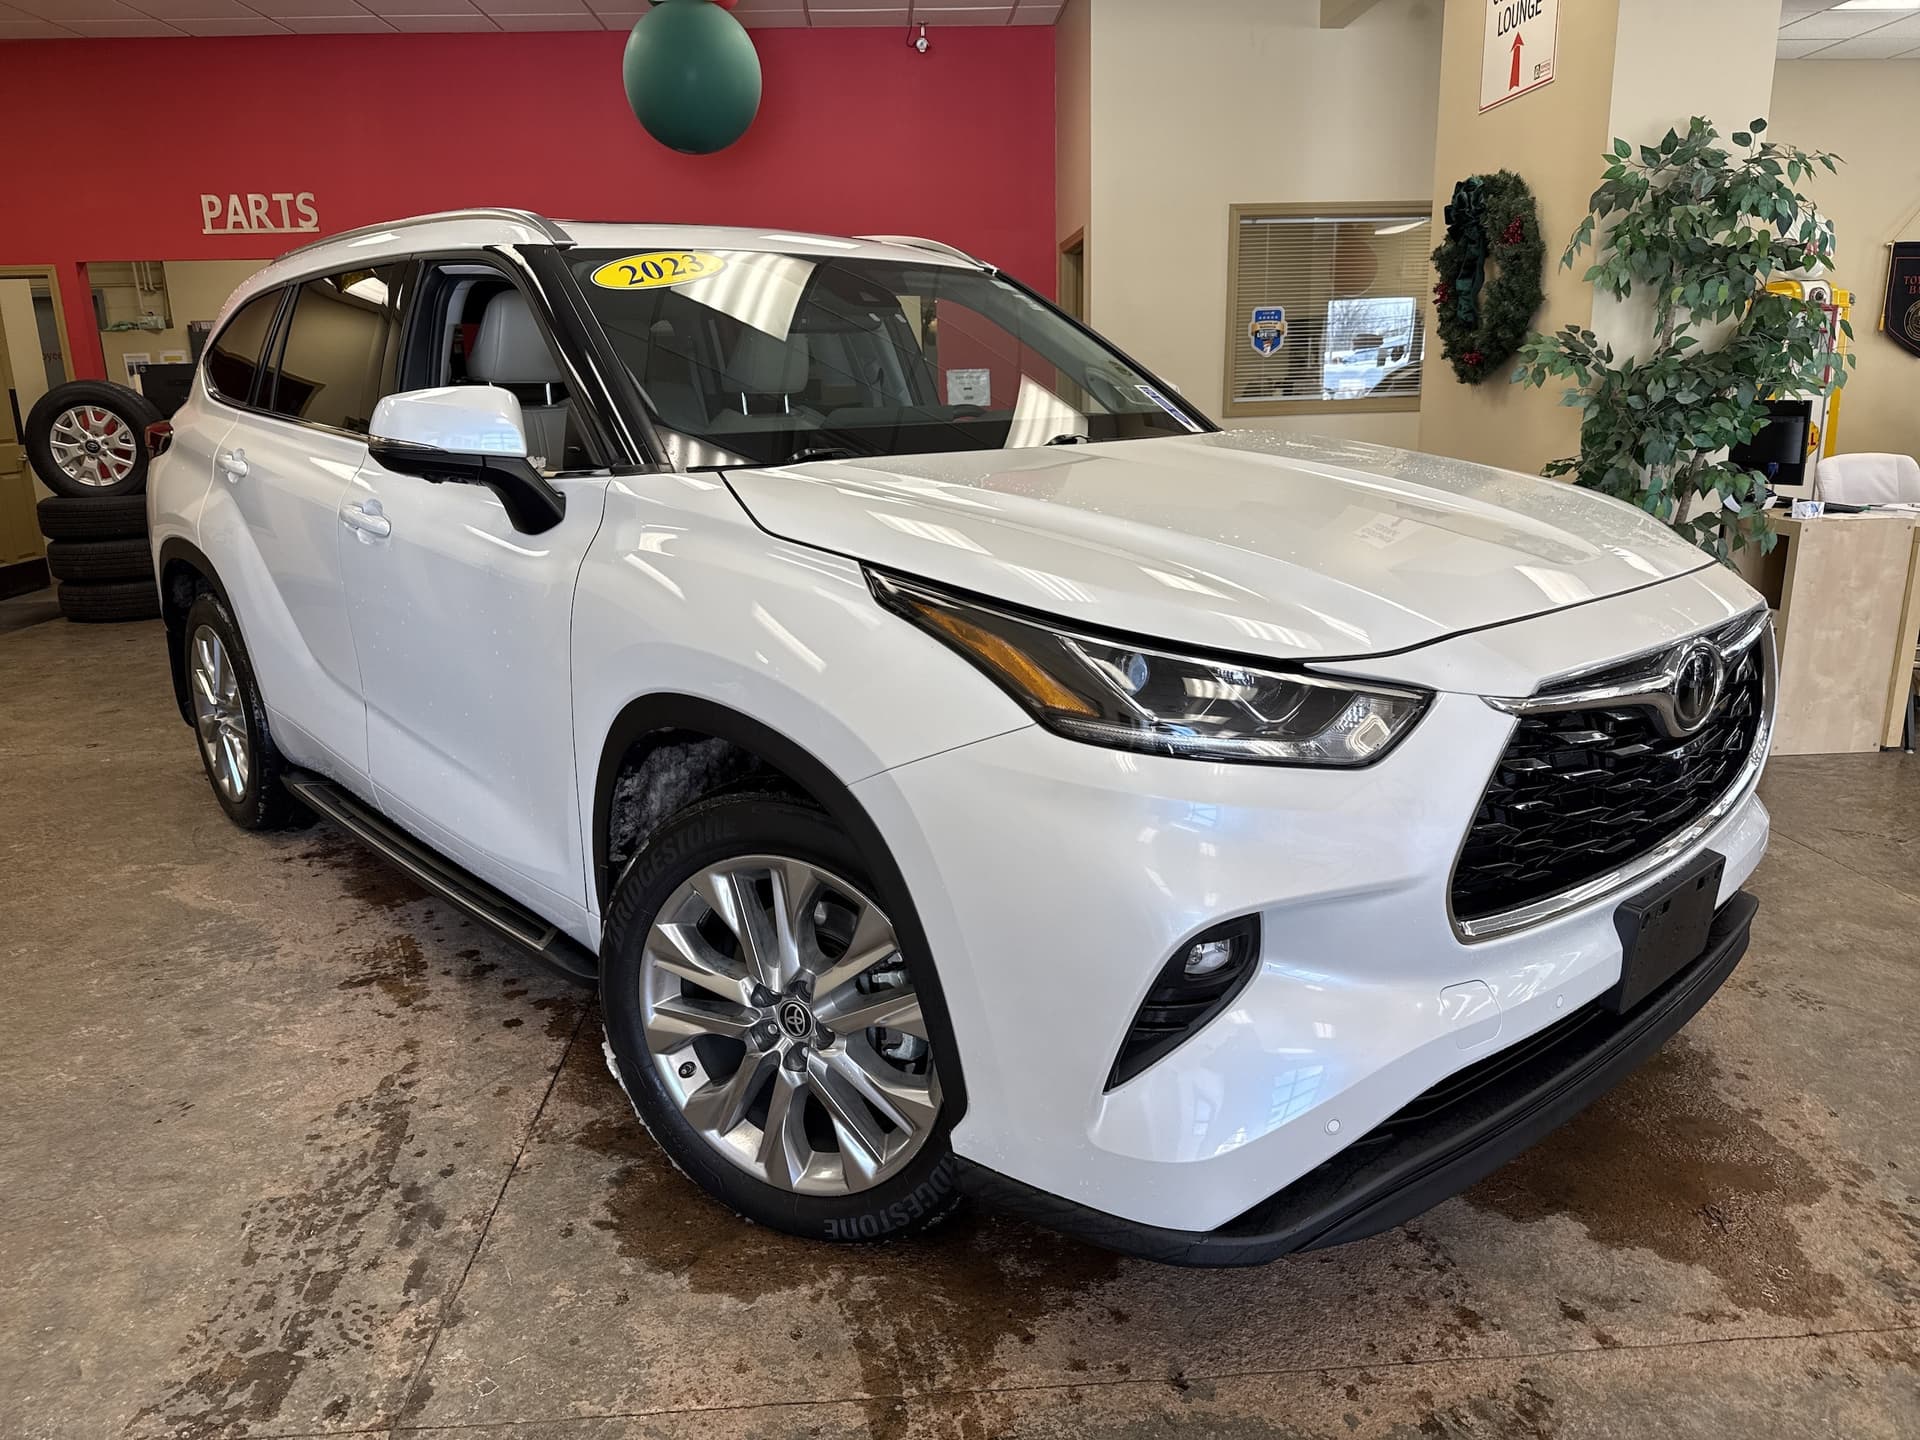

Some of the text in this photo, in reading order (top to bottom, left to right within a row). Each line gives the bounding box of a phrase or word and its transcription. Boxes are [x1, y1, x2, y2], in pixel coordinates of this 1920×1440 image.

[1497, 0, 1542, 37] LOUNGE
[200, 192, 320, 234] PARTS
[618, 254, 704, 285] 2023
[606, 815, 738, 952] BRIDGESTONE
[823, 1151, 954, 1241] IDGESTONE
